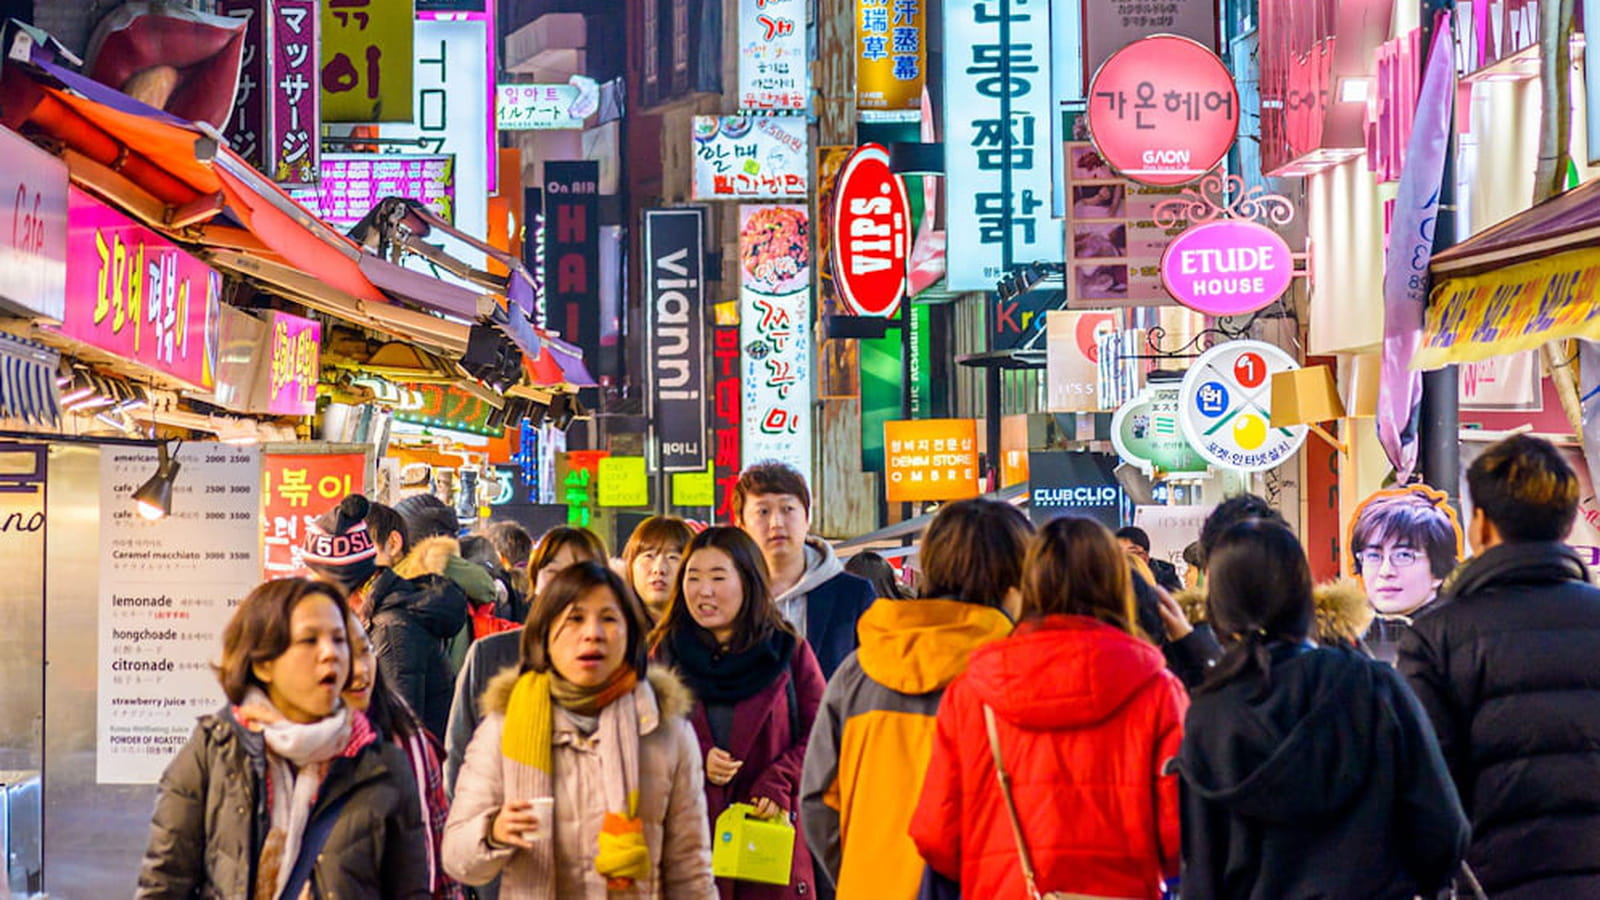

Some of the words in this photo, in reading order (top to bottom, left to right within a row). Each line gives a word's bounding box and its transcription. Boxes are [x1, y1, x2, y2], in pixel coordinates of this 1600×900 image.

[862, 0, 889, 60] 瑞草
[280, 7, 310, 163] マッサージ
[1096, 82, 1232, 129] 가온헤어
[1142, 149, 1190, 164] GAON
[547, 181, 569, 194] On
[571, 181, 595, 194] AIR
[12, 182, 44, 254] Cafe
[1181, 246, 1276, 275] ETUDE
[1192, 277, 1265, 296] HOUSE
[656, 248, 699, 400] vianni
[113, 453, 161, 463] american
[891, 455, 930, 468] DENIM
[933, 453, 973, 466] STORE
[891, 467, 973, 483] OMBRE
[112, 483, 133, 493] cafe
[1074, 486, 1117, 501] CLIO
[112, 550, 151, 560] Caramel
[152, 550, 200, 560] macchiato
[112, 594, 173, 607] lemonade
[112, 628, 178, 643] hongchoade
[111, 658, 175, 672] citronade
[111, 697, 162, 708] strawberry
[163, 697, 187, 708] juice
[110, 735, 142, 745] POWDER
[142, 735, 153, 745] OF
